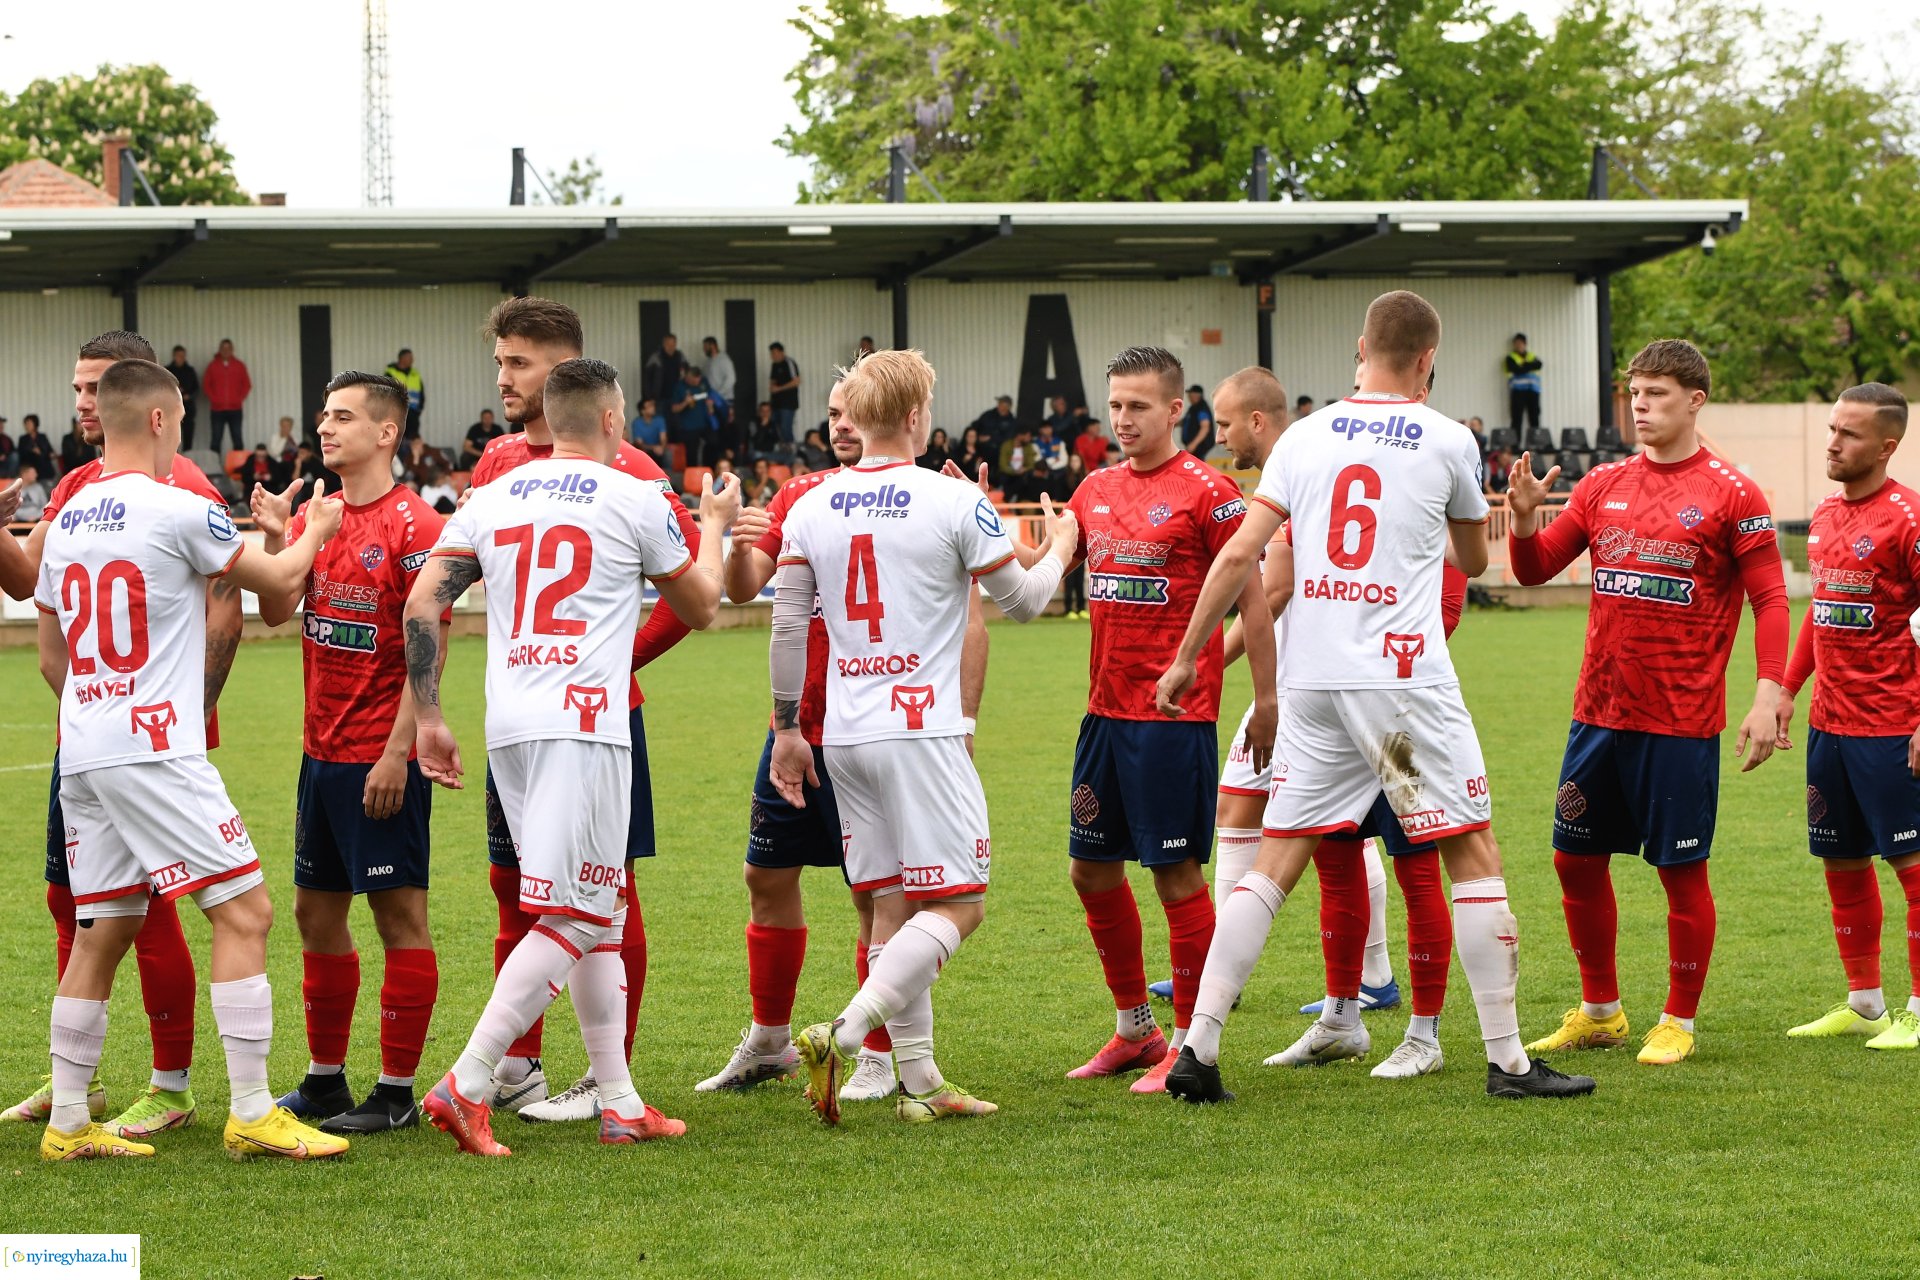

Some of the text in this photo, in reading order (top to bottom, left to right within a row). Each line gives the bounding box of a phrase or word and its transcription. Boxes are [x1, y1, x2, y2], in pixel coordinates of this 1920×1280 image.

[1331, 416, 1423, 441] apollo
[1375, 436, 1420, 451] TYRES
[510, 473, 598, 500] apollo
[548, 491, 596, 504] TYRES
[830, 484, 911, 518] apollo
[866, 508, 909, 519] TYRES
[1092, 504, 1110, 514] JAKO
[1604, 501, 1628, 511] JAKO
[60, 497, 126, 536] apollo
[87, 521, 126, 533] TYRES
[1326, 463, 1382, 571] 6
[494, 522, 593, 640] 72
[844, 533, 885, 644] 4
[1304, 574, 1398, 606] BÁRDOS
[61, 559, 150, 677] 20
[507, 644, 579, 669] FARKAS
[837, 653, 921, 678] BOKROS
[1162, 837, 1187, 849] JAKO
[1675, 838, 1699, 850] JAKO
[1893, 829, 1918, 843] JAKO
[366, 864, 394, 877] JAKO
